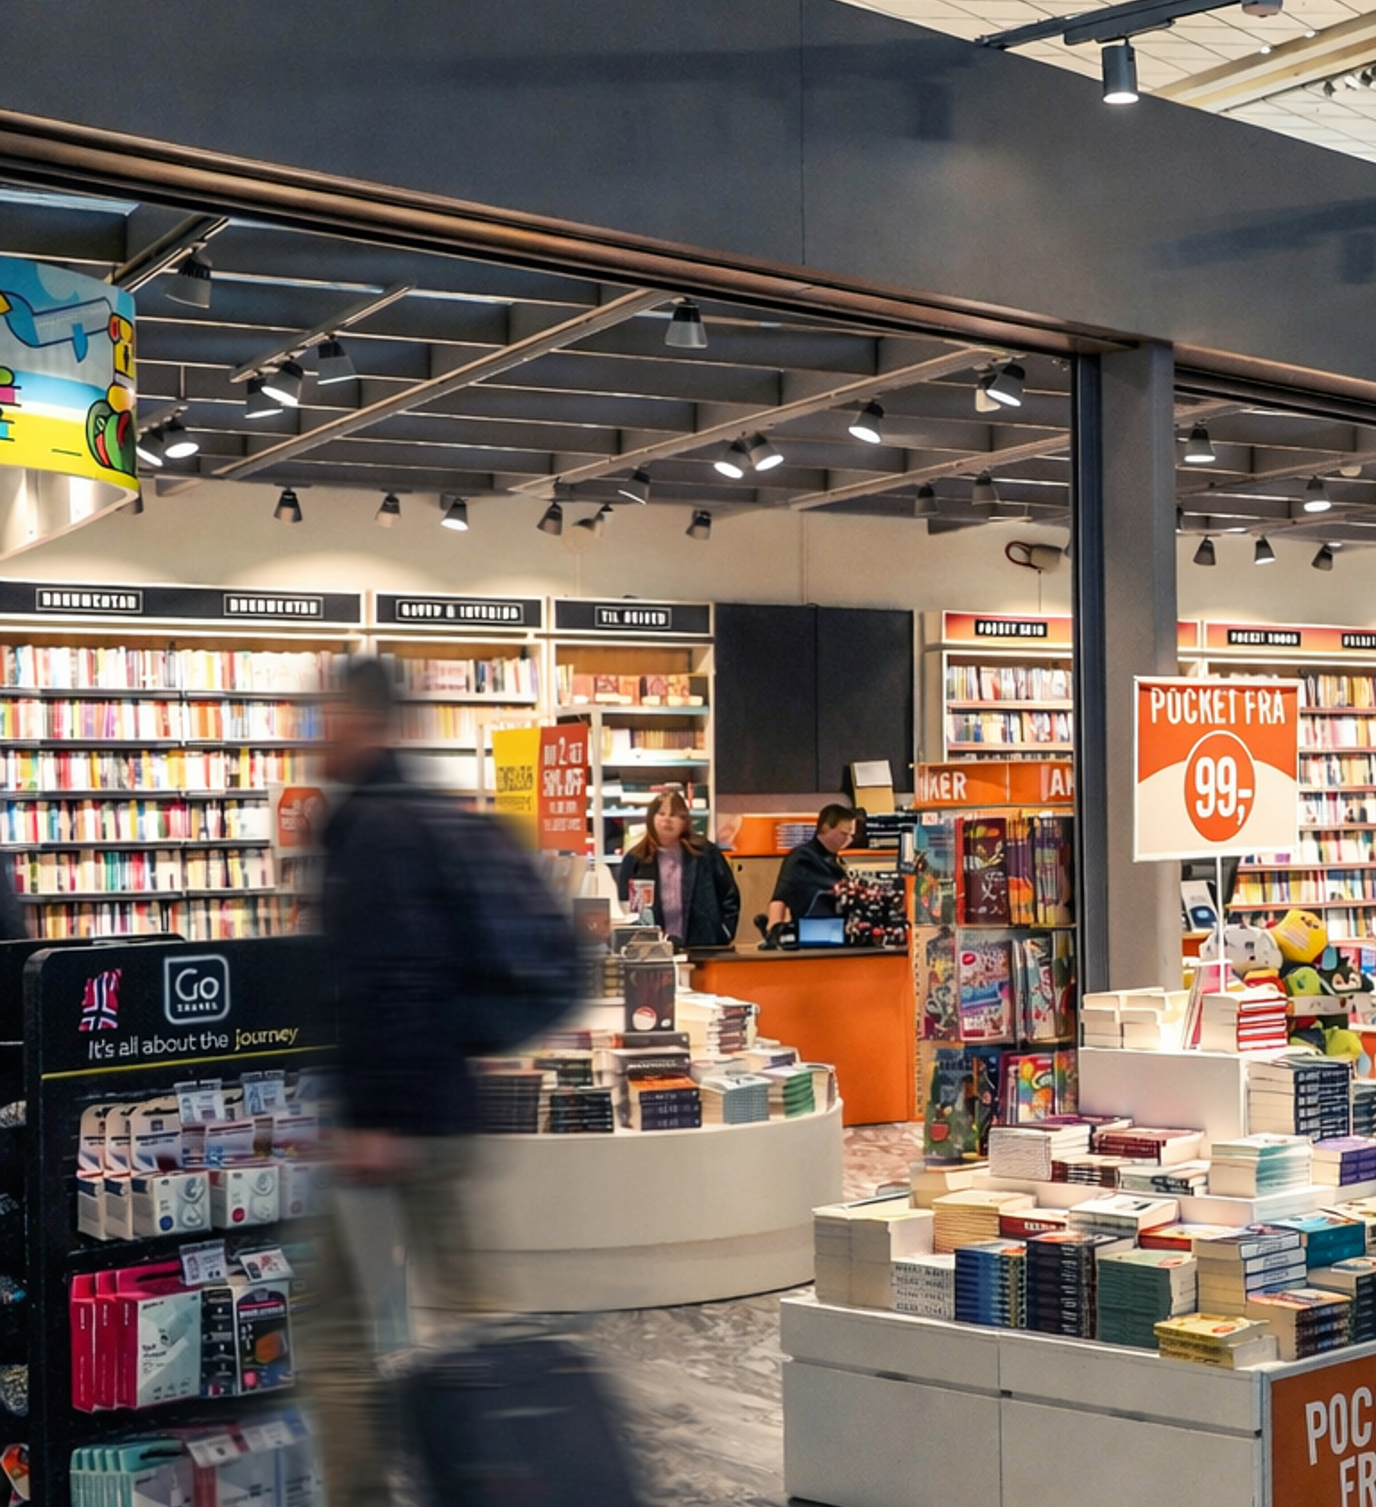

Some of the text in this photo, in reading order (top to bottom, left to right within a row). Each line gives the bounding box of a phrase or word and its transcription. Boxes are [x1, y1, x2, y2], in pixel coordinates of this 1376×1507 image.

[1150, 687, 1286, 725] POCKET FRA
[1195, 756, 1253, 826] 99,-
[175, 967, 220, 1002] Go
[88, 1027, 299, 1060] It's all about the journey
